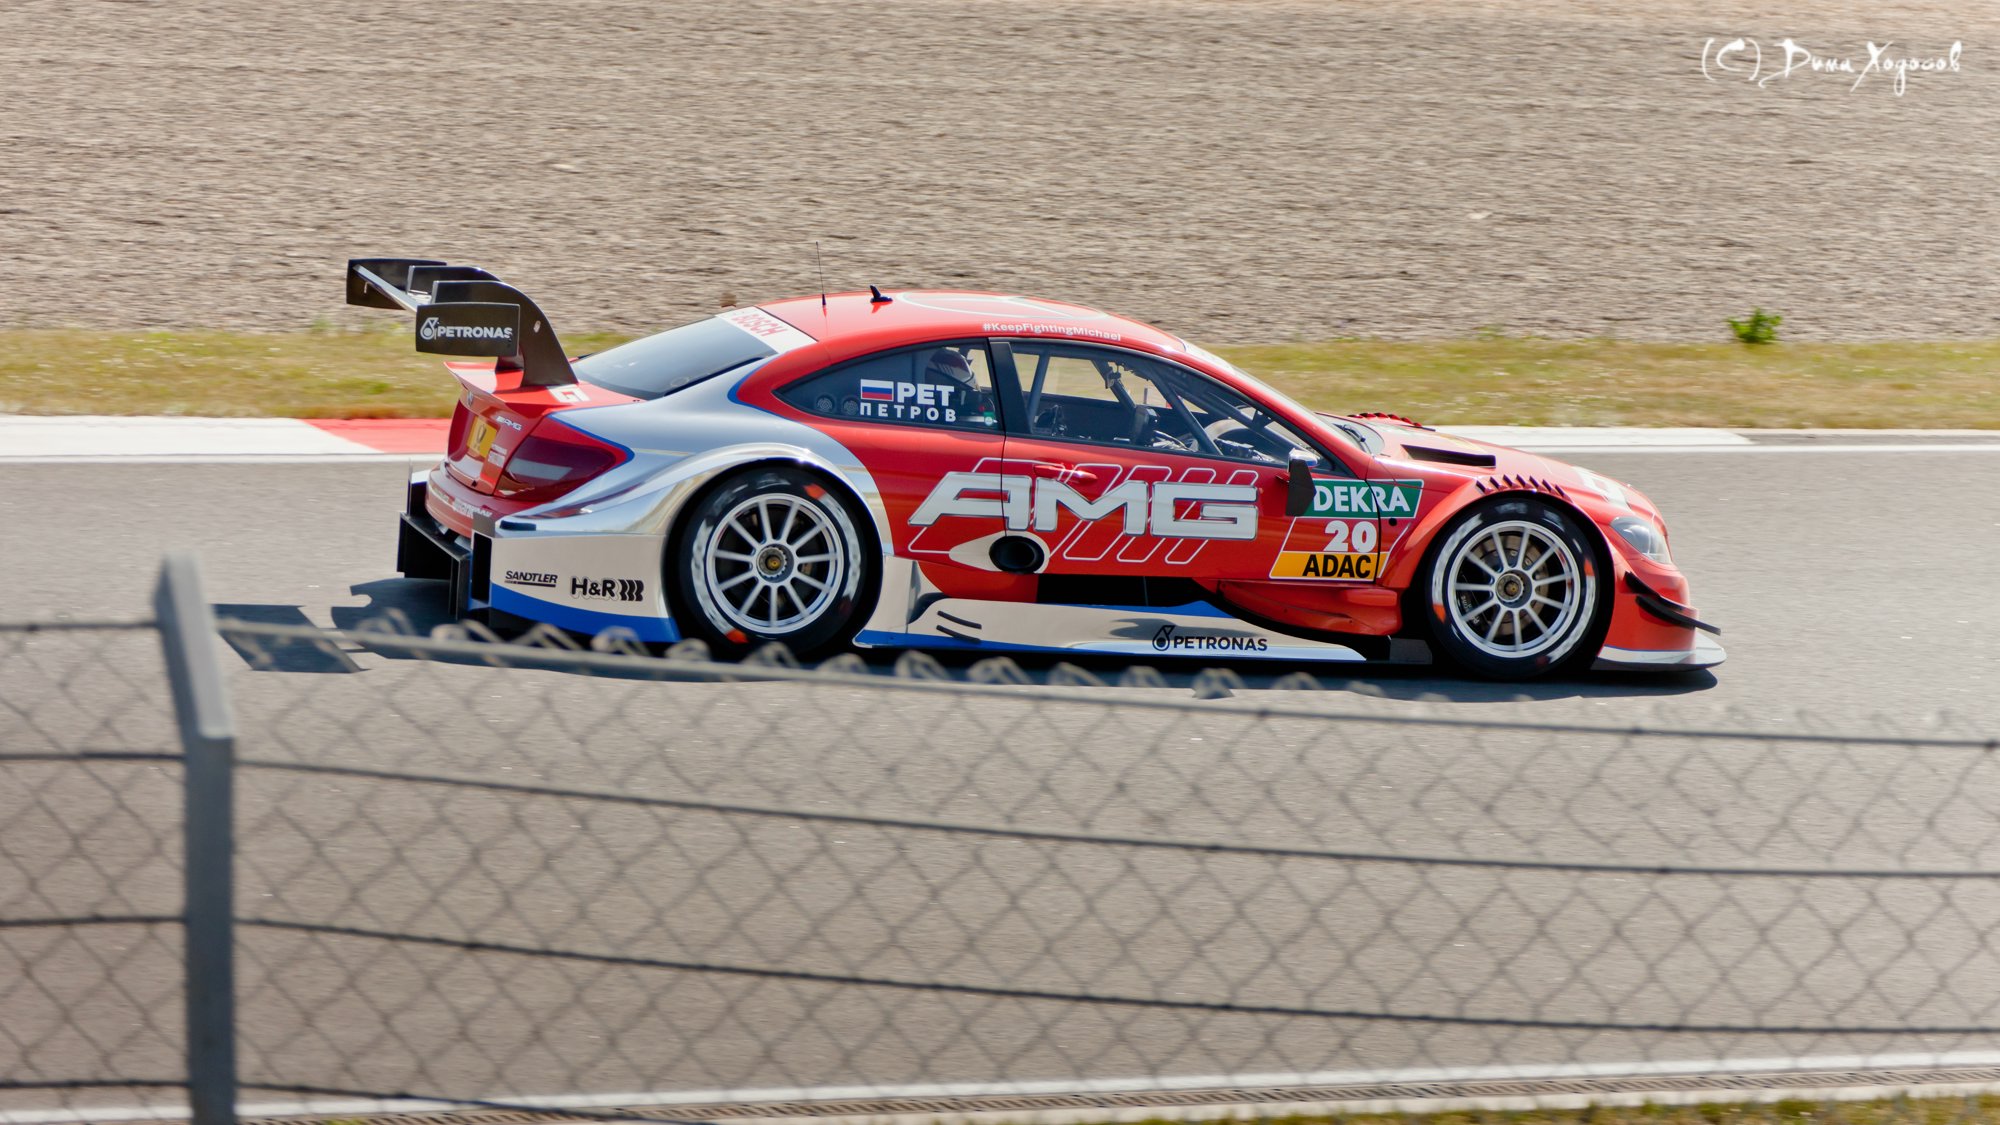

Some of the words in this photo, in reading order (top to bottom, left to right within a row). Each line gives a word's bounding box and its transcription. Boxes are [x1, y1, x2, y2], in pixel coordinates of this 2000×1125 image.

[437, 326, 513, 339] PETRONAS
[983, 322, 1122, 341] #KeepFightingMichael
[860, 402, 957, 422] ПЕТРОВ
[907, 471, 1258, 540] AMG
[1313, 485, 1411, 513] DEKRA
[1323, 520, 1377, 553] 20
[1302, 554, 1372, 579] ADAC
[505, 570, 558, 584] SANDTLER
[571, 577, 617, 598] H&R
[1173, 635, 1268, 652] PETRONAS
